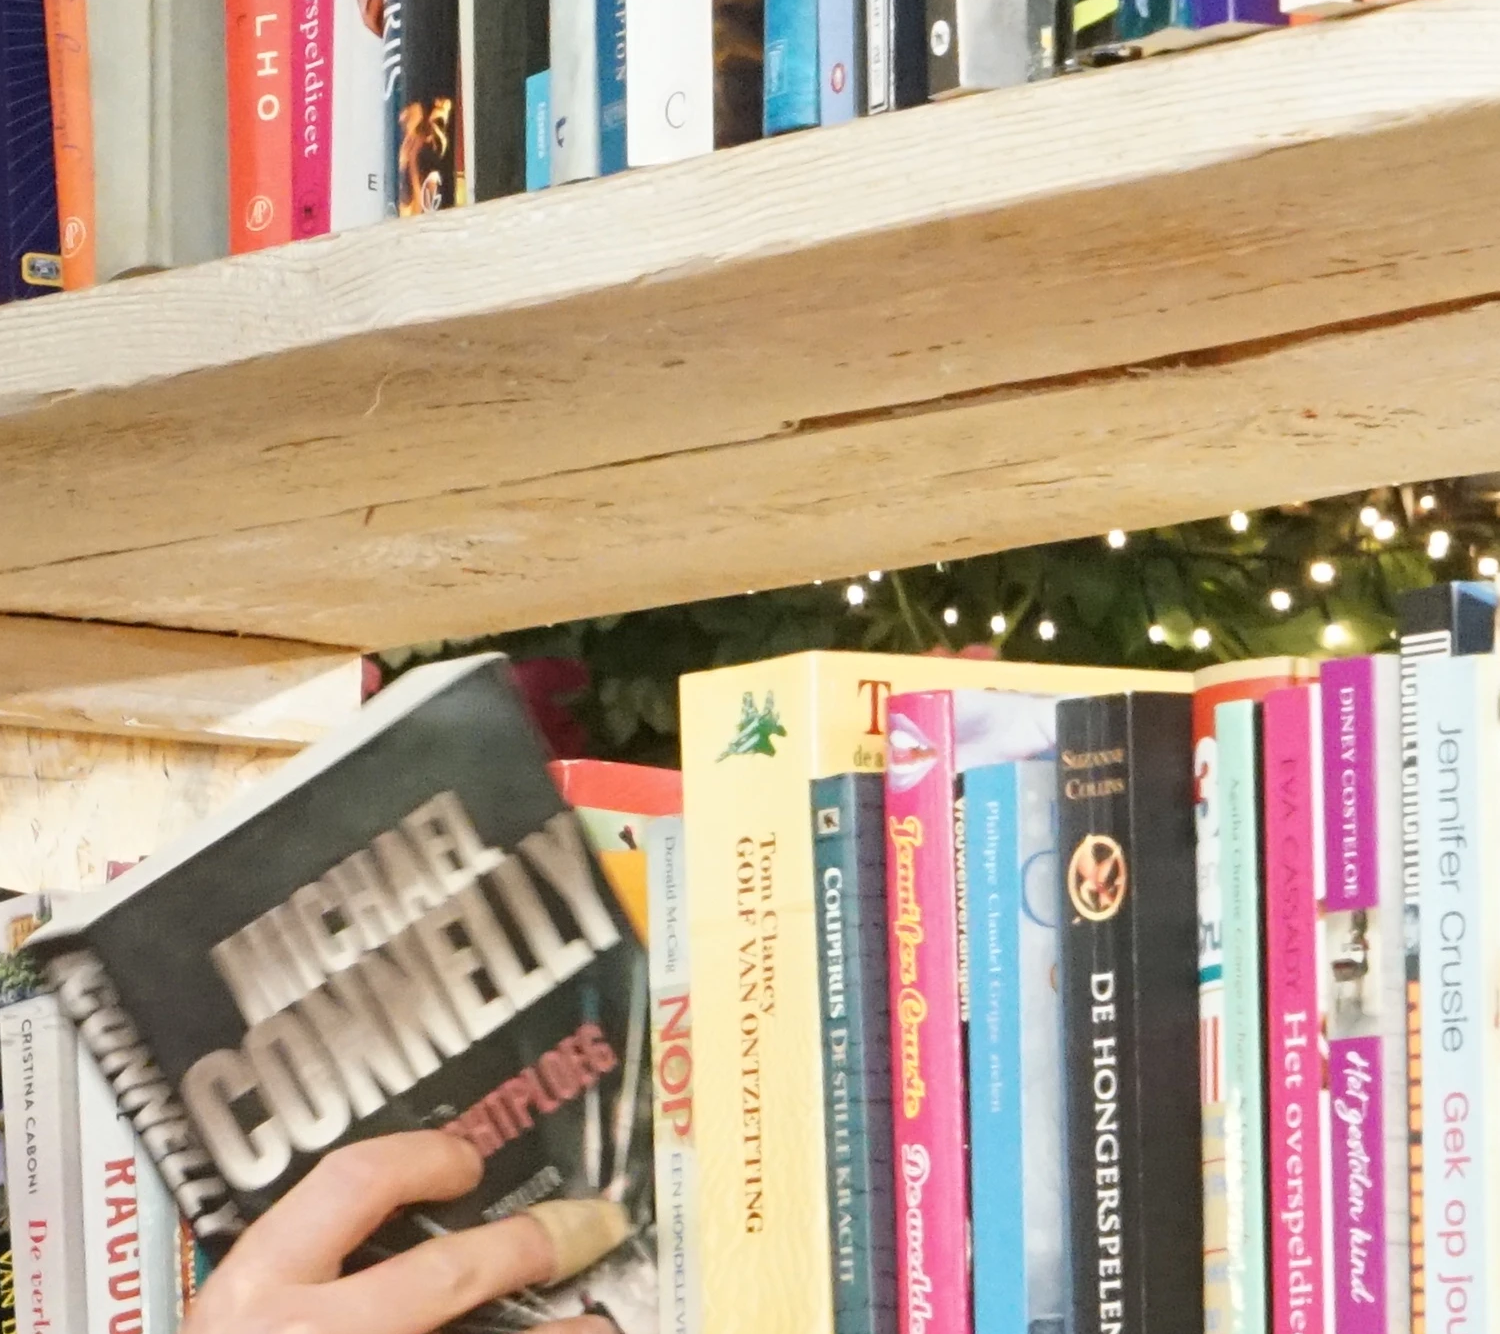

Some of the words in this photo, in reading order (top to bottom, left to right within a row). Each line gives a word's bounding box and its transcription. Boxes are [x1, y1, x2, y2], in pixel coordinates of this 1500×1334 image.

[1437, 722, 1464, 892] Jennifer
[211, 791, 505, 1026] MICHAEL
[737, 835, 756, 914] GOLF
[761, 832, 777, 902] Tom
[739, 921, 758, 990] VAN
[759, 907, 778, 1019] Clancy
[1088, 971, 1117, 1022] DE
[1439, 911, 1466, 1053] Crusie
[192, 812, 621, 1192] CONNELLY
[21, 1019, 36, 1110] CRISTINA
[657, 997, 693, 1136] NOP
[25, 1117, 38, 1195] CABONI
[741, 991, 764, 1235] ONTZETTING
[1443, 1092, 1470, 1179] Gek
[671, 1152, 684, 1191] EEN
[28, 1220, 48, 1257] De
[1445, 1199, 1466, 1259] op
